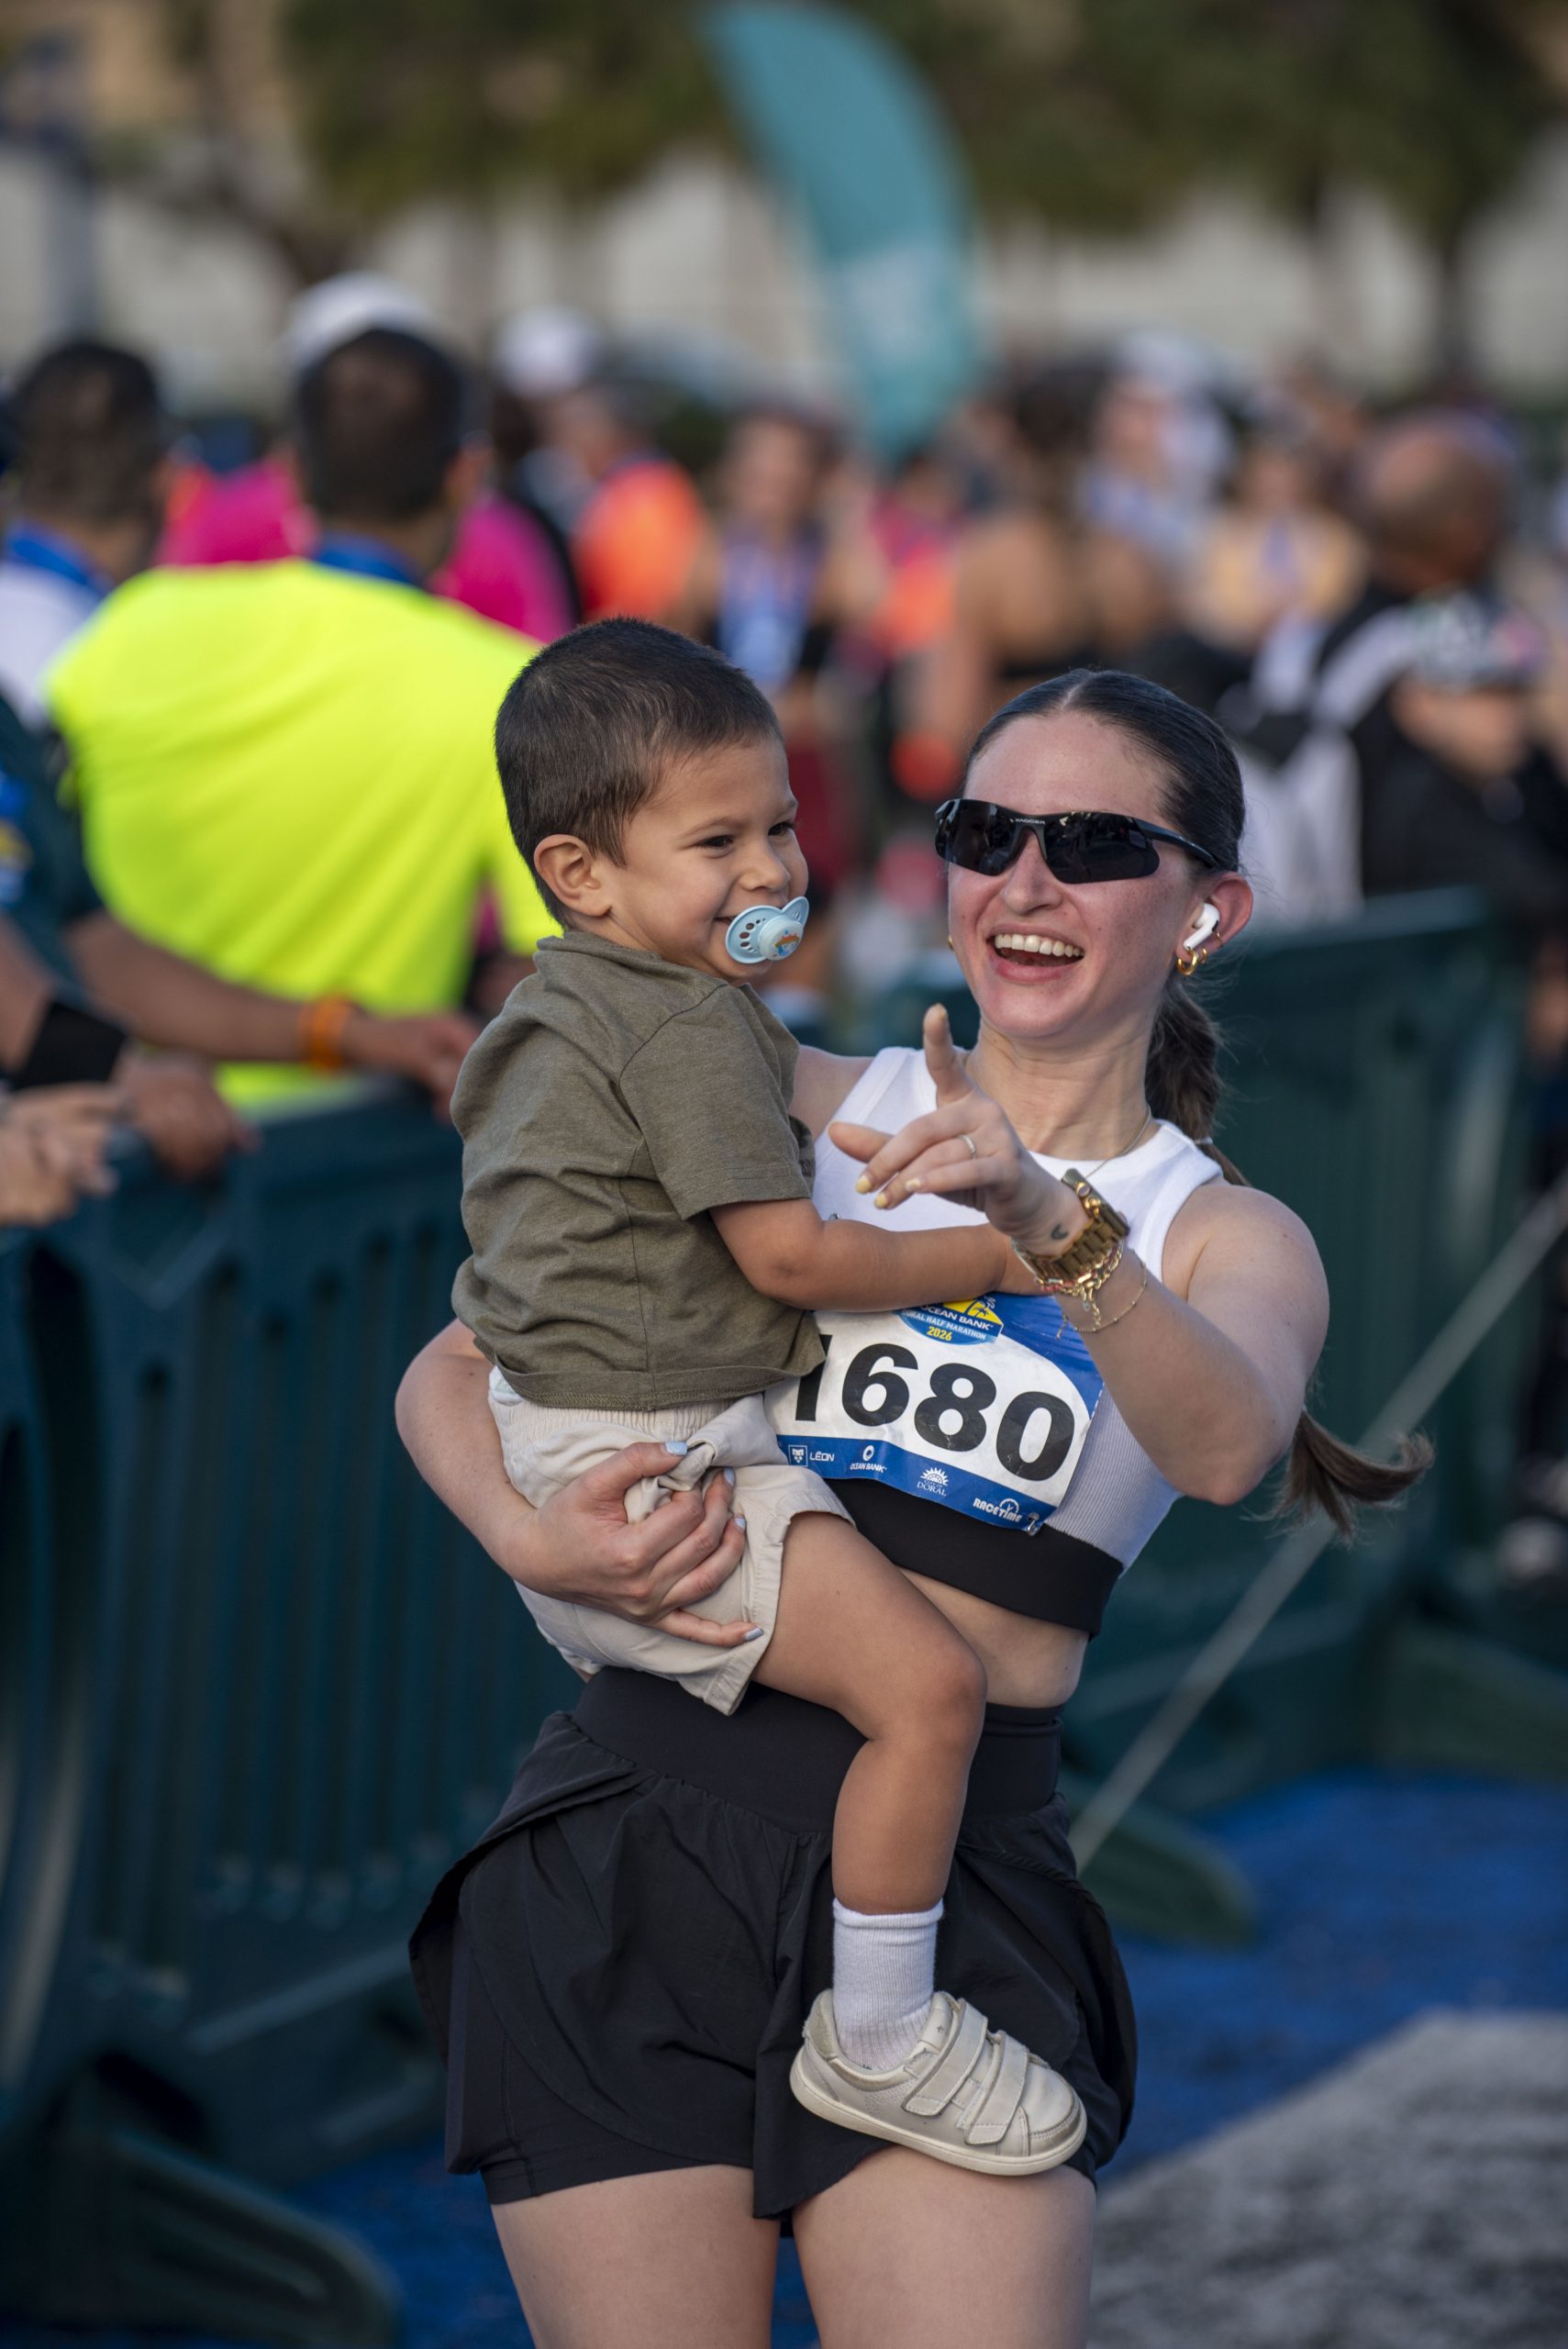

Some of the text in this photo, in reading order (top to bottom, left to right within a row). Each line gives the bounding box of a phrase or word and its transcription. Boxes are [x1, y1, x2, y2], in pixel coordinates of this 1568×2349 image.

[926, 1315, 945, 1327] HALF
[946, 1322, 986, 1340] MARATHON
[959, 1315, 991, 1330] BANK
[927, 1326, 952, 1341] 2026
[795, 1333, 1075, 1481] 1680
[866, 1464, 884, 1473] BANK
[917, 1481, 947, 1497] DORAL
[973, 1497, 1022, 1522] RACETIME
